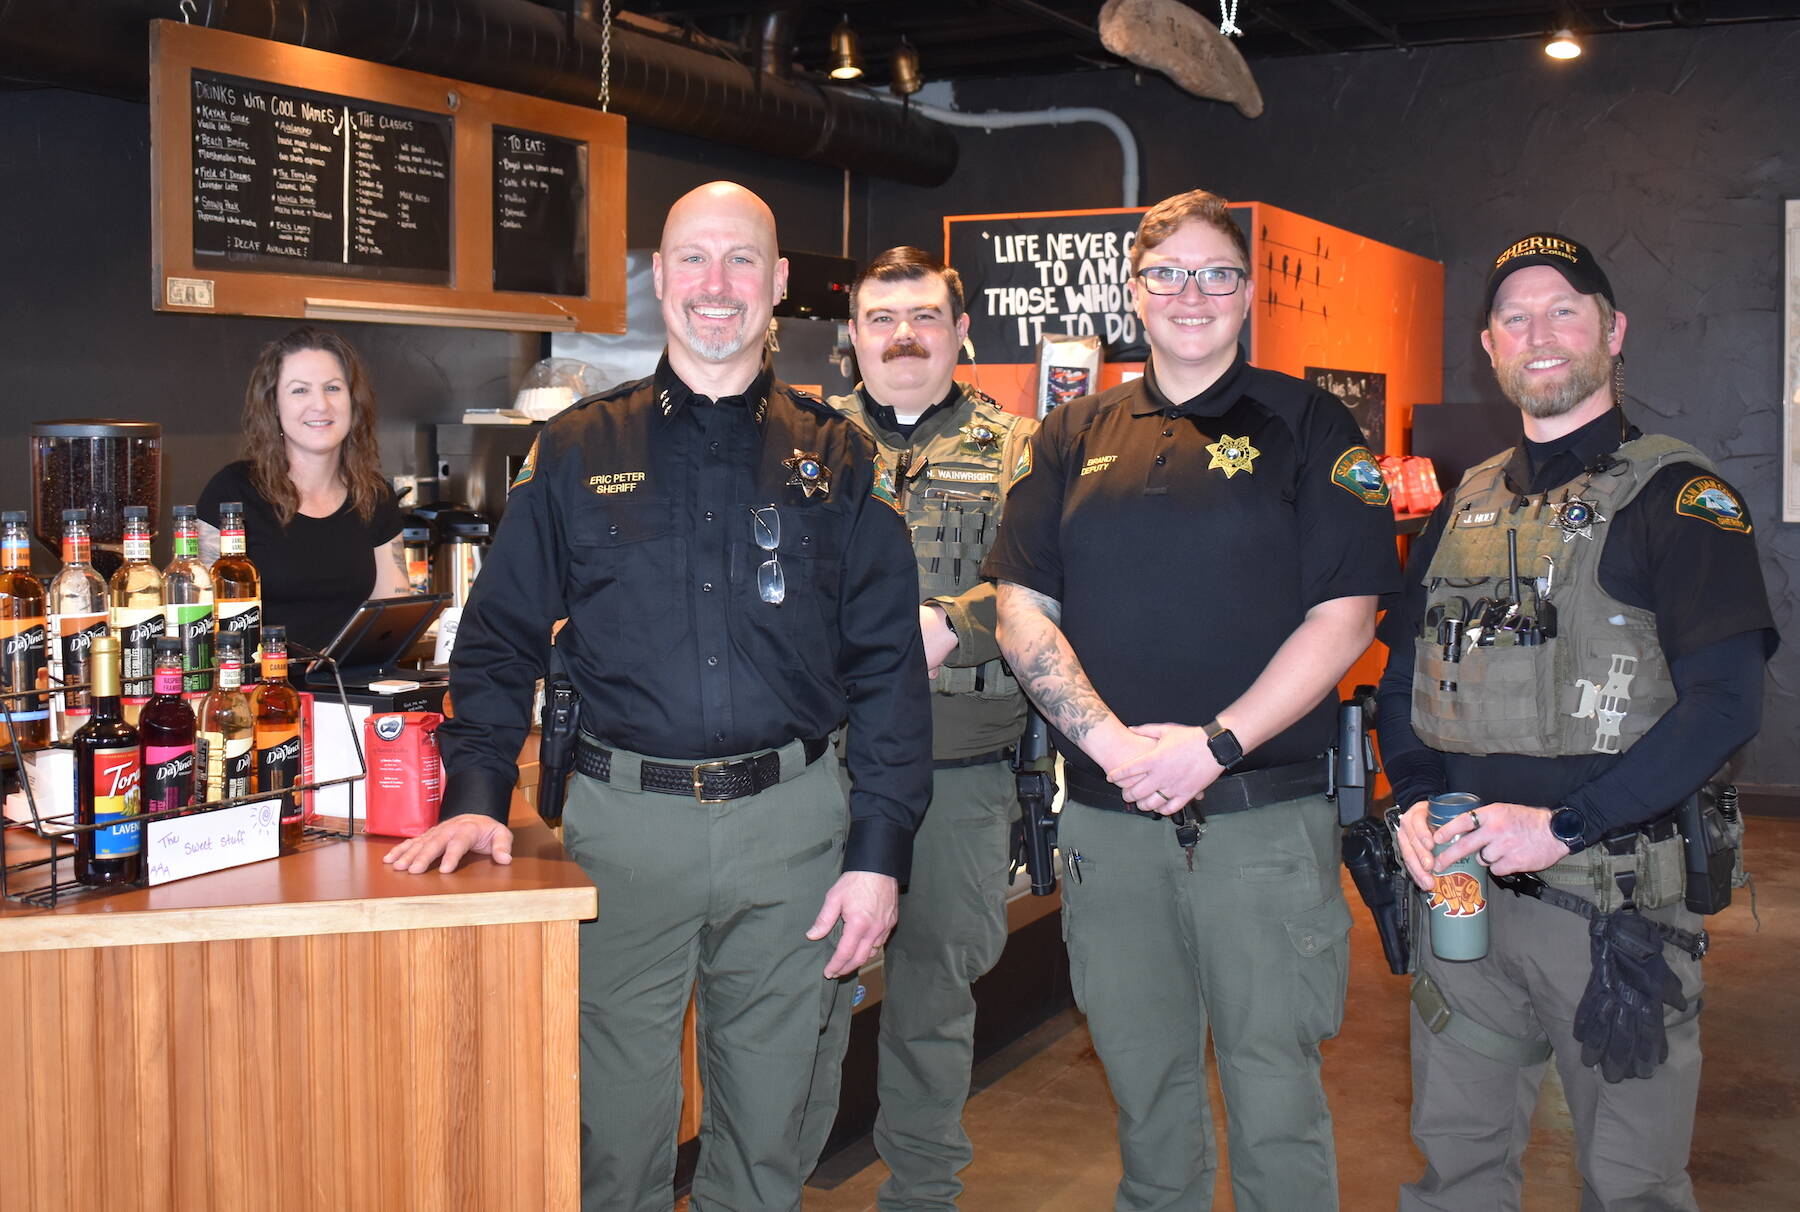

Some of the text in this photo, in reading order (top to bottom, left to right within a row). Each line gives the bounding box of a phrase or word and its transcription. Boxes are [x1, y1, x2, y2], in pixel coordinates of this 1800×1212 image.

[195, 81, 236, 105] DRINKS
[271, 96, 297, 117] COOL
[301, 102, 335, 124] NAMES
[357, 111, 375, 128] THE
[508, 135, 521, 150] TO
[994, 234, 1041, 263] LIFE
[1047, 231, 1120, 261] NEVER
[1496, 236, 1577, 269] SHERIFF
[1539, 248, 1579, 264] County
[1035, 257, 1132, 287] TO AMA
[984, 287, 1060, 316] THOSE
[1017, 316, 1046, 346] IT
[1060, 312, 1094, 337] TO
[1105, 312, 1137, 344] DO
[1081, 463, 1110, 475] DEPUTY
[1087, 455, 1118, 466] BRANDT
[590, 472, 645, 485] ERIC PETER
[938, 470, 994, 481] WAINWRIGHT
[596, 483, 637, 494] SHERIFF
[7, 629, 44, 655] DaVinci
[130, 618, 164, 642] DaVinci
[267, 740, 300, 764] DaVinci
[156, 755, 193, 780] DaVinci
[158, 832, 180, 848] The
[184, 837, 212, 855] Sweet
